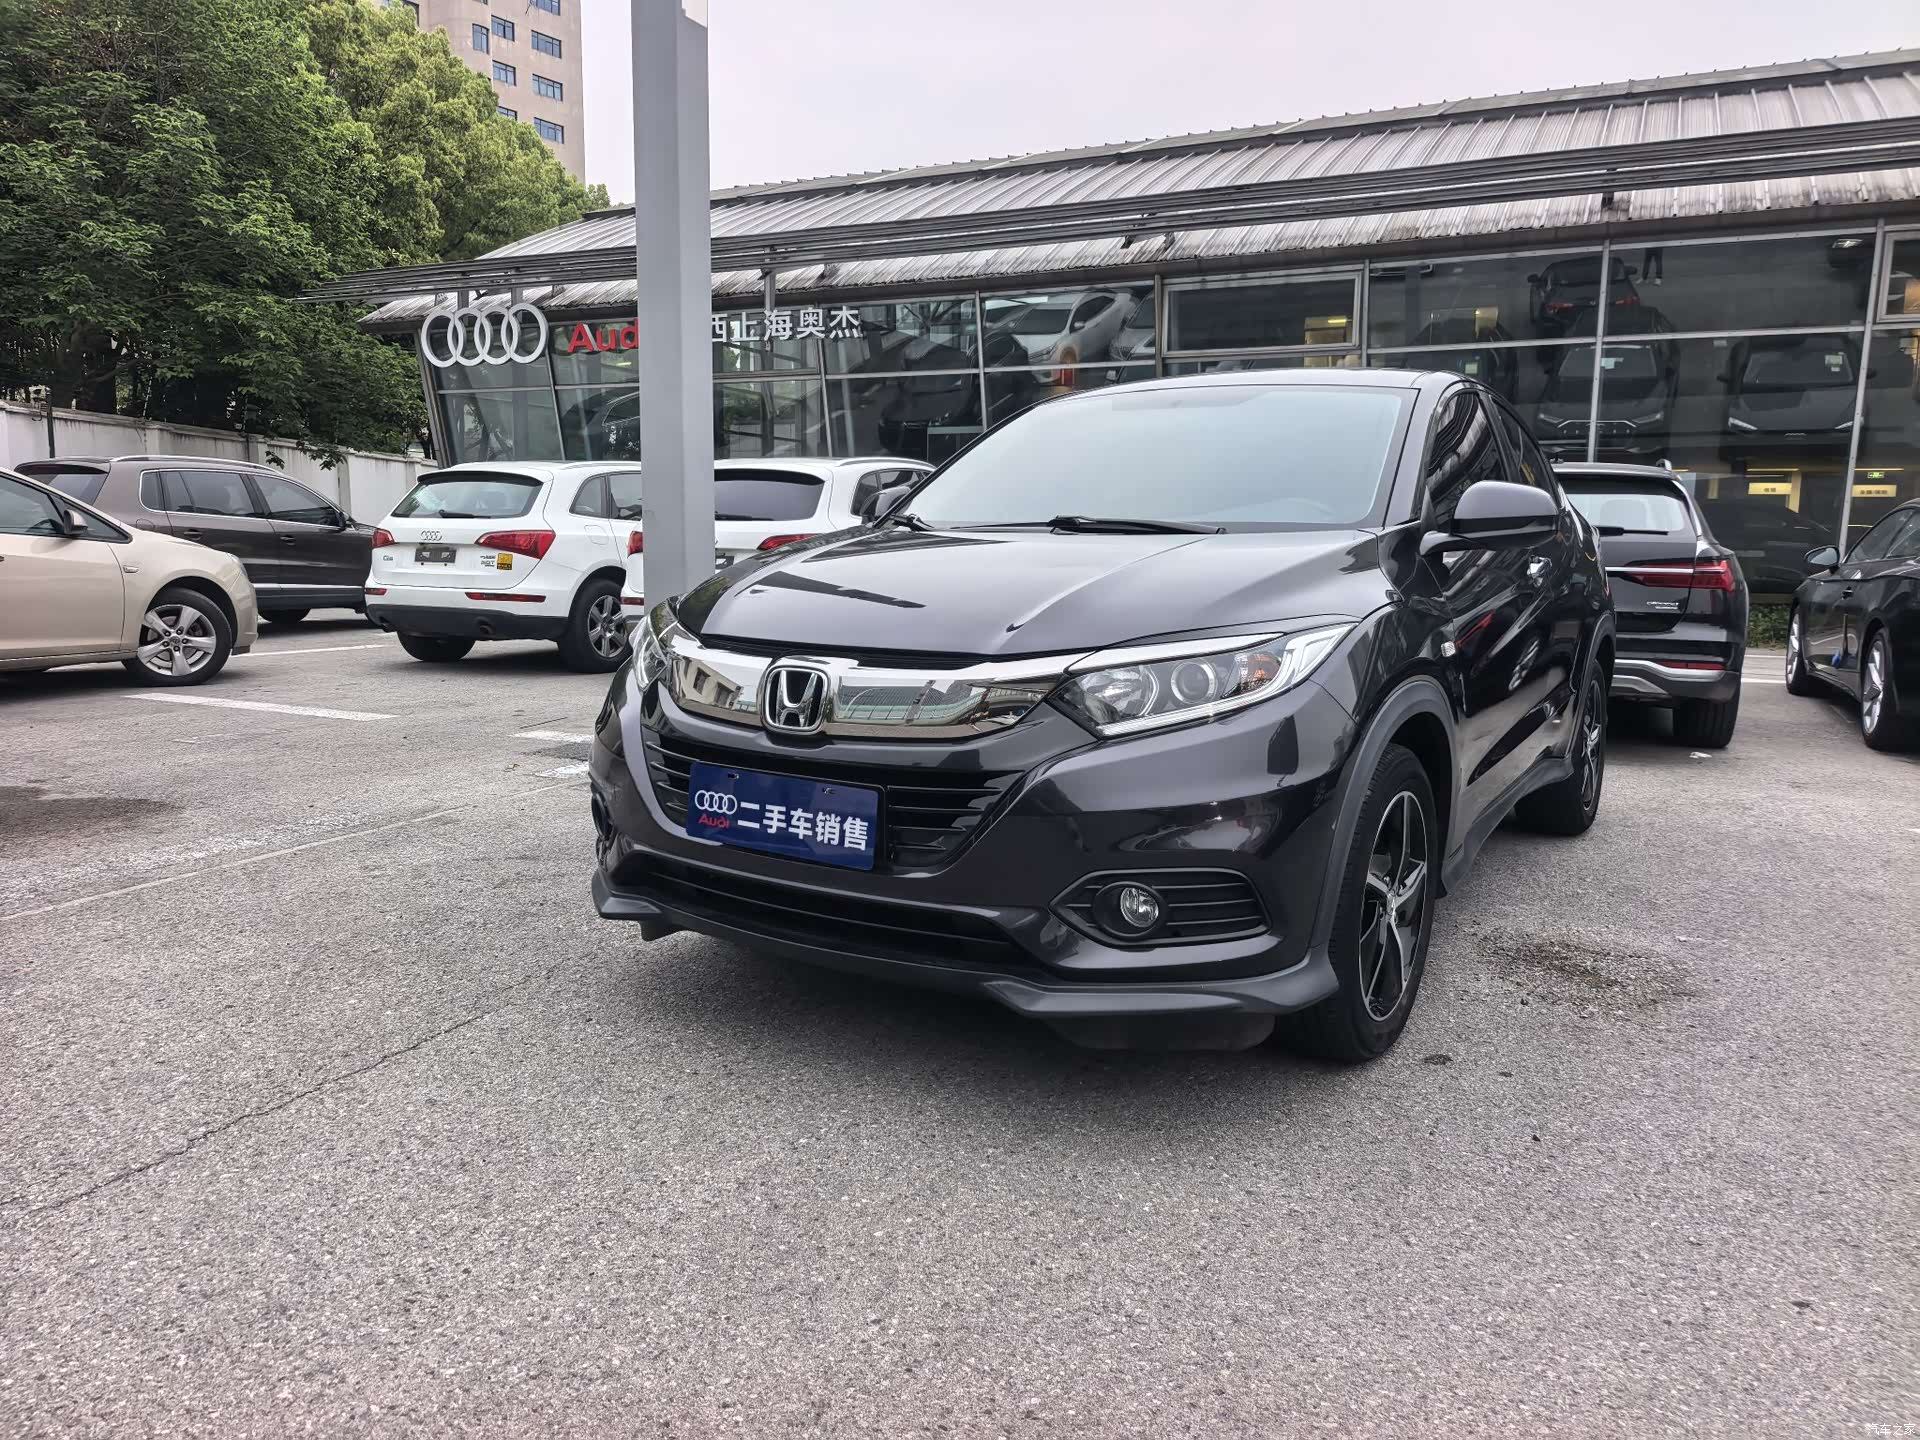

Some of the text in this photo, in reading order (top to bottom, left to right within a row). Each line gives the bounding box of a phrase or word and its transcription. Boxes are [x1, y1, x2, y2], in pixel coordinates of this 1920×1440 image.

[567, 319, 639, 353] Aud
[698, 813, 730, 829] Audi
[737, 801, 869, 851] 二手车销售
